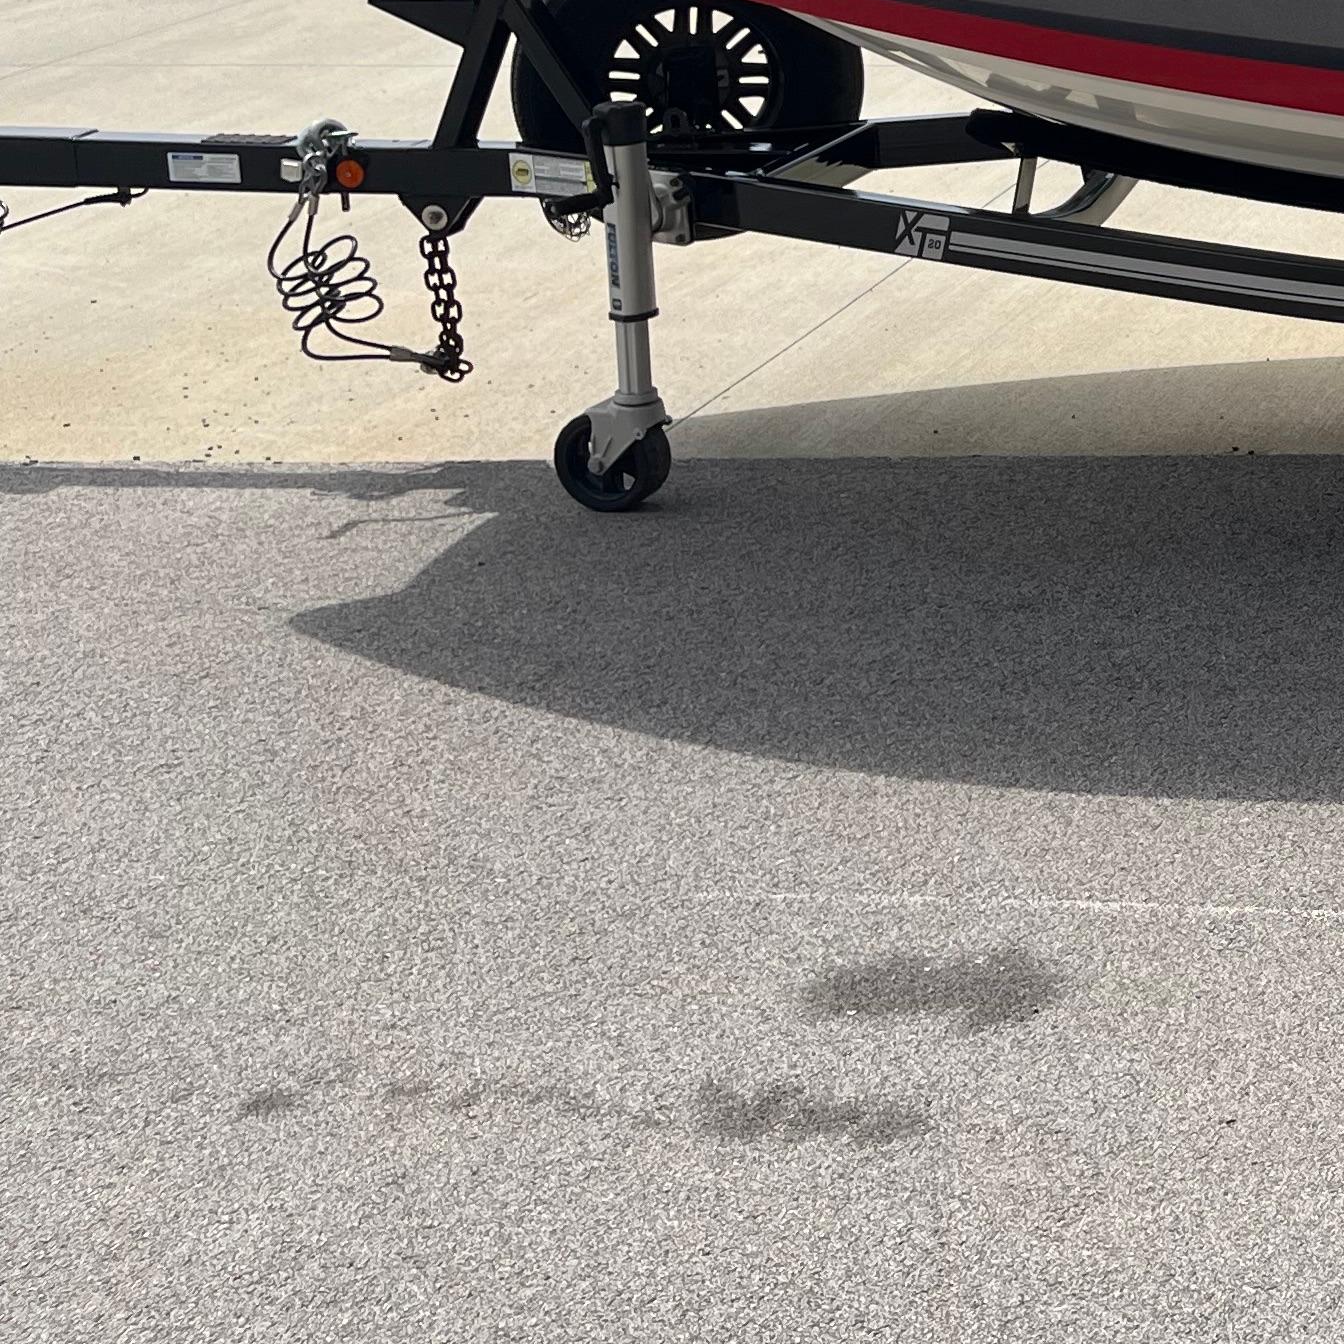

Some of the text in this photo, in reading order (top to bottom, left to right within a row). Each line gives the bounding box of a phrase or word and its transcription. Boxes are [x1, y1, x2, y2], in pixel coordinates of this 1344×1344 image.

[606, 223, 620, 288] FULTON
[894, 208, 950, 259] XT 20
